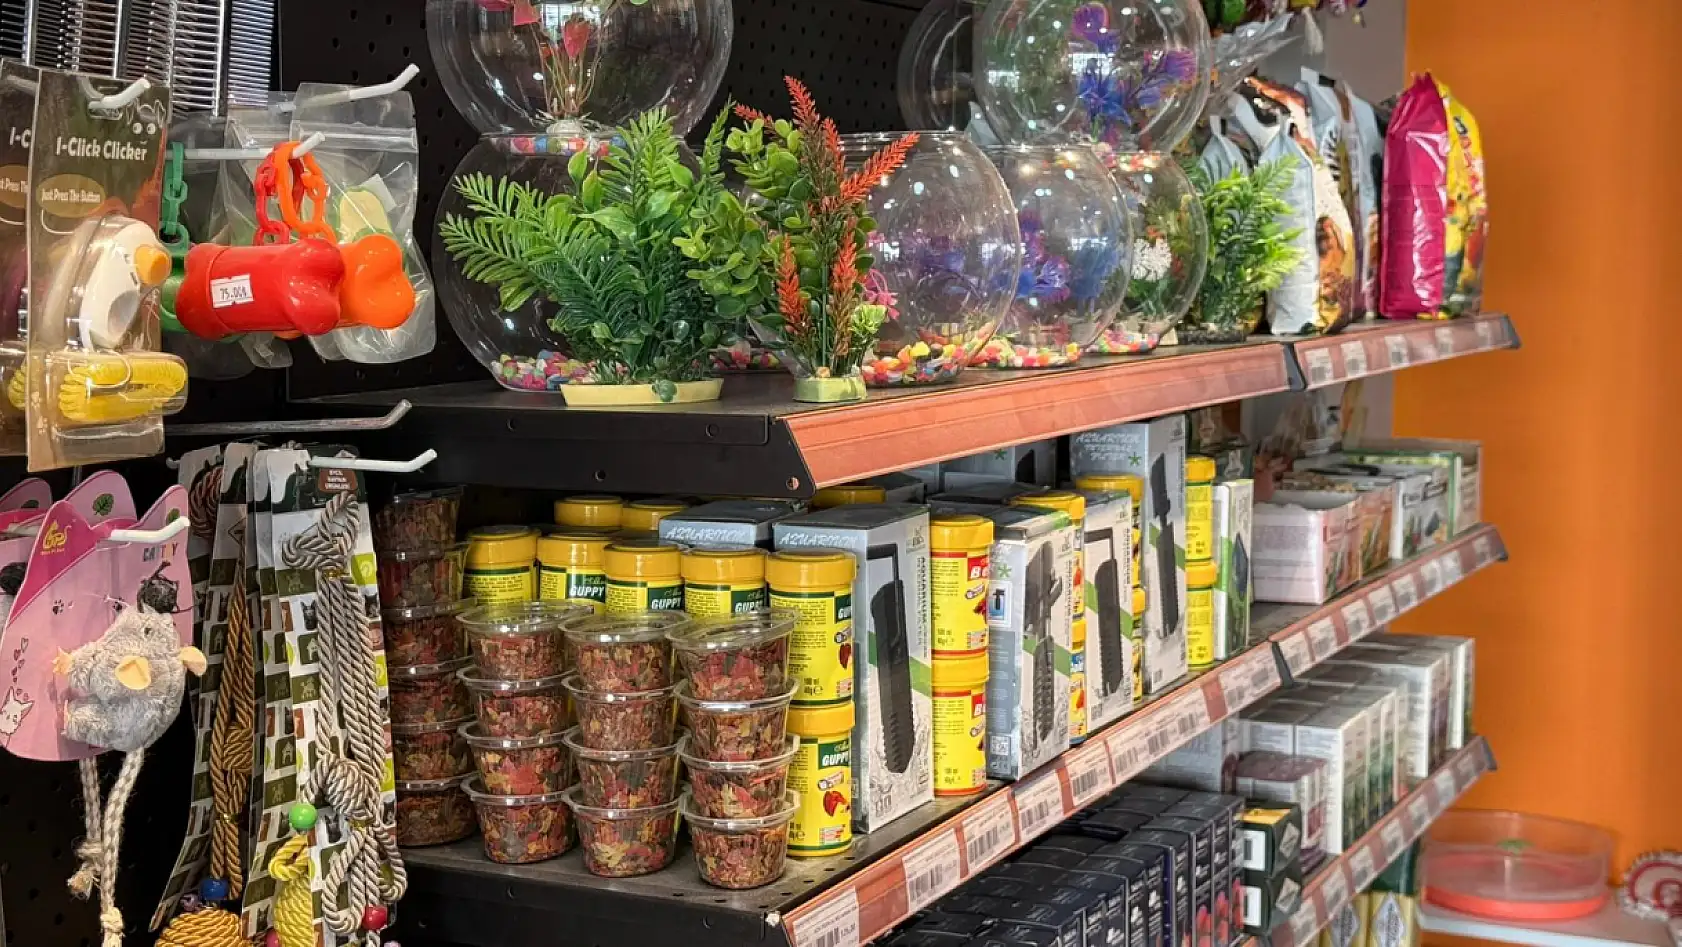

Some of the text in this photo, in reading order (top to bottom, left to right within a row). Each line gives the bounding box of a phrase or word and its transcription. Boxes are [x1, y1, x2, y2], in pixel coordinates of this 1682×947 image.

[56, 136, 148, 161] I-Click Clicker
[54, 188, 69, 201] Press
[69, 189, 80, 202] The
[569, 585, 604, 597] GUPPY
[651, 597, 682, 610] GUPPY
